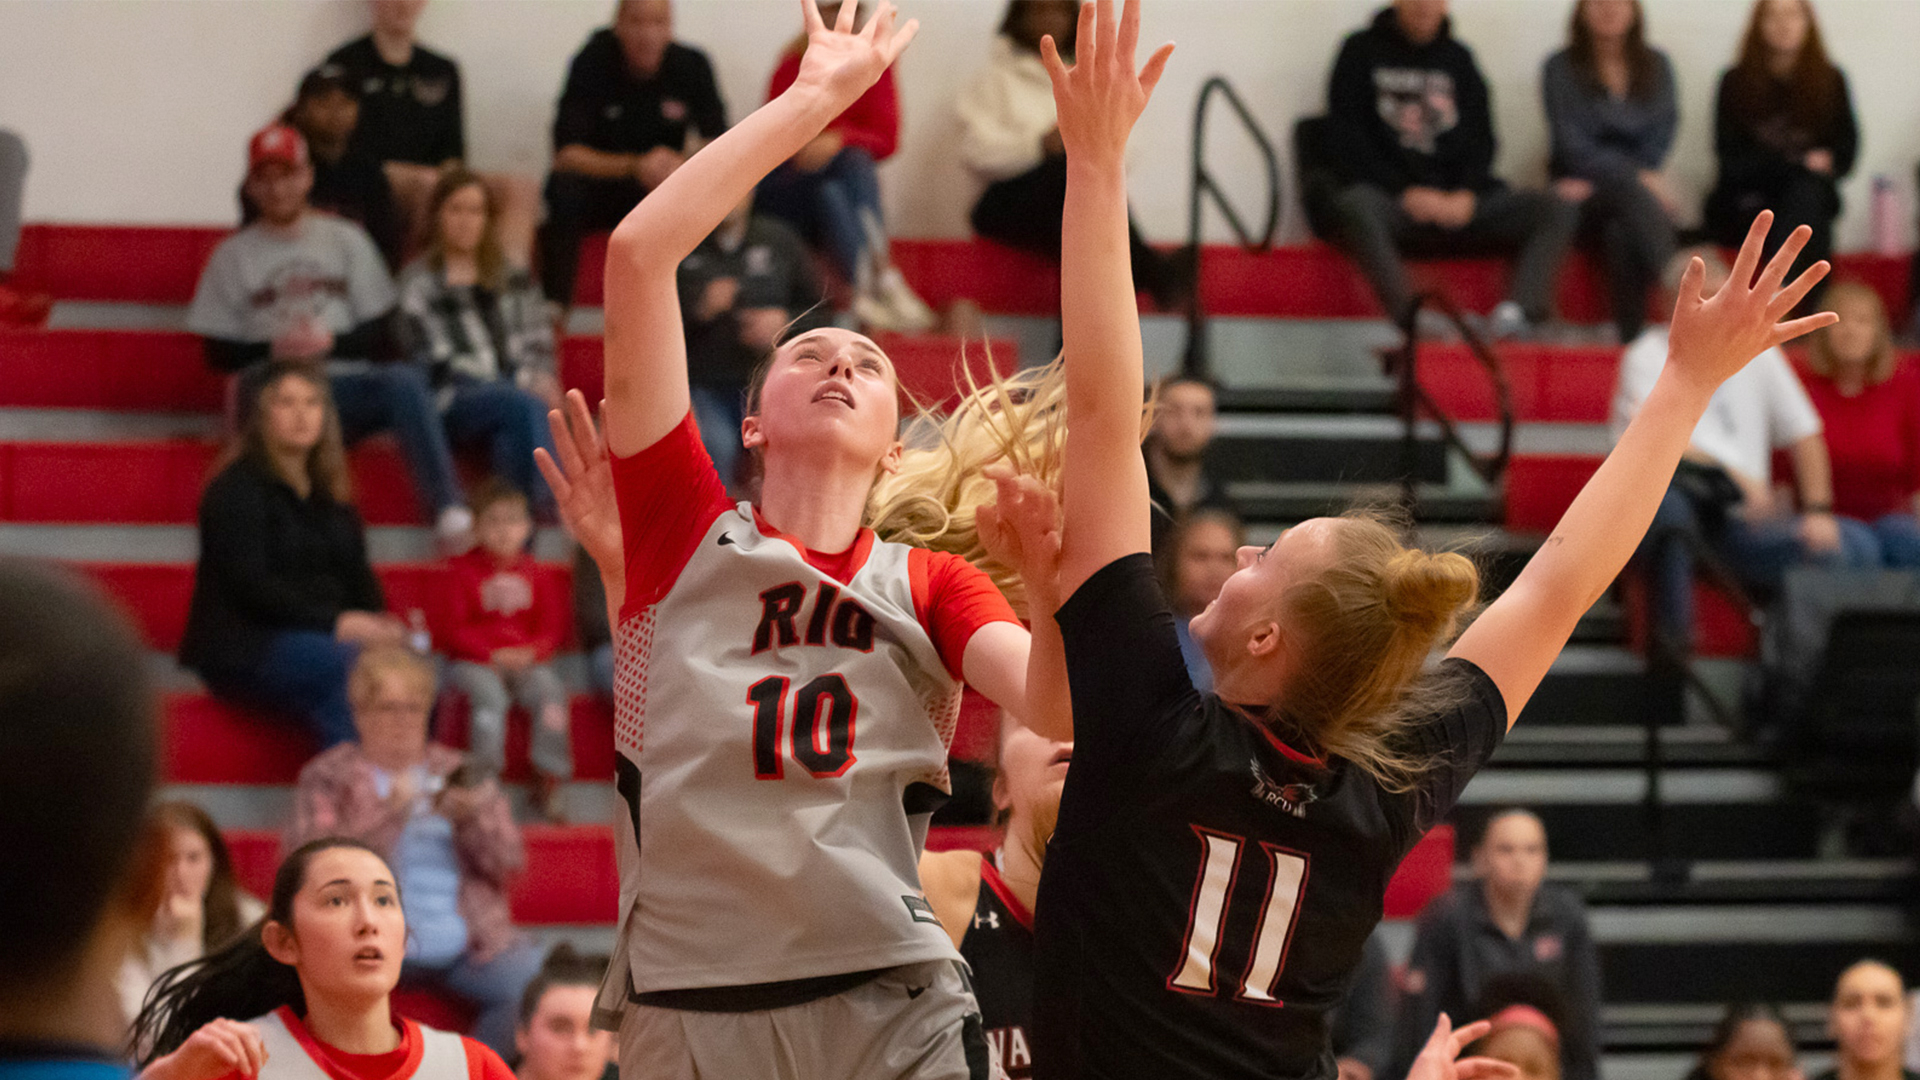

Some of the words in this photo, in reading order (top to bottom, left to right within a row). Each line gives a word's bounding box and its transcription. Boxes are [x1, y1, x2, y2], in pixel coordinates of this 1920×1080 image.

[751, 580, 876, 654] RIO
[746, 673, 858, 780] 10
[1265, 791, 1292, 813] RCU
[1164, 823, 1311, 1008] 11
